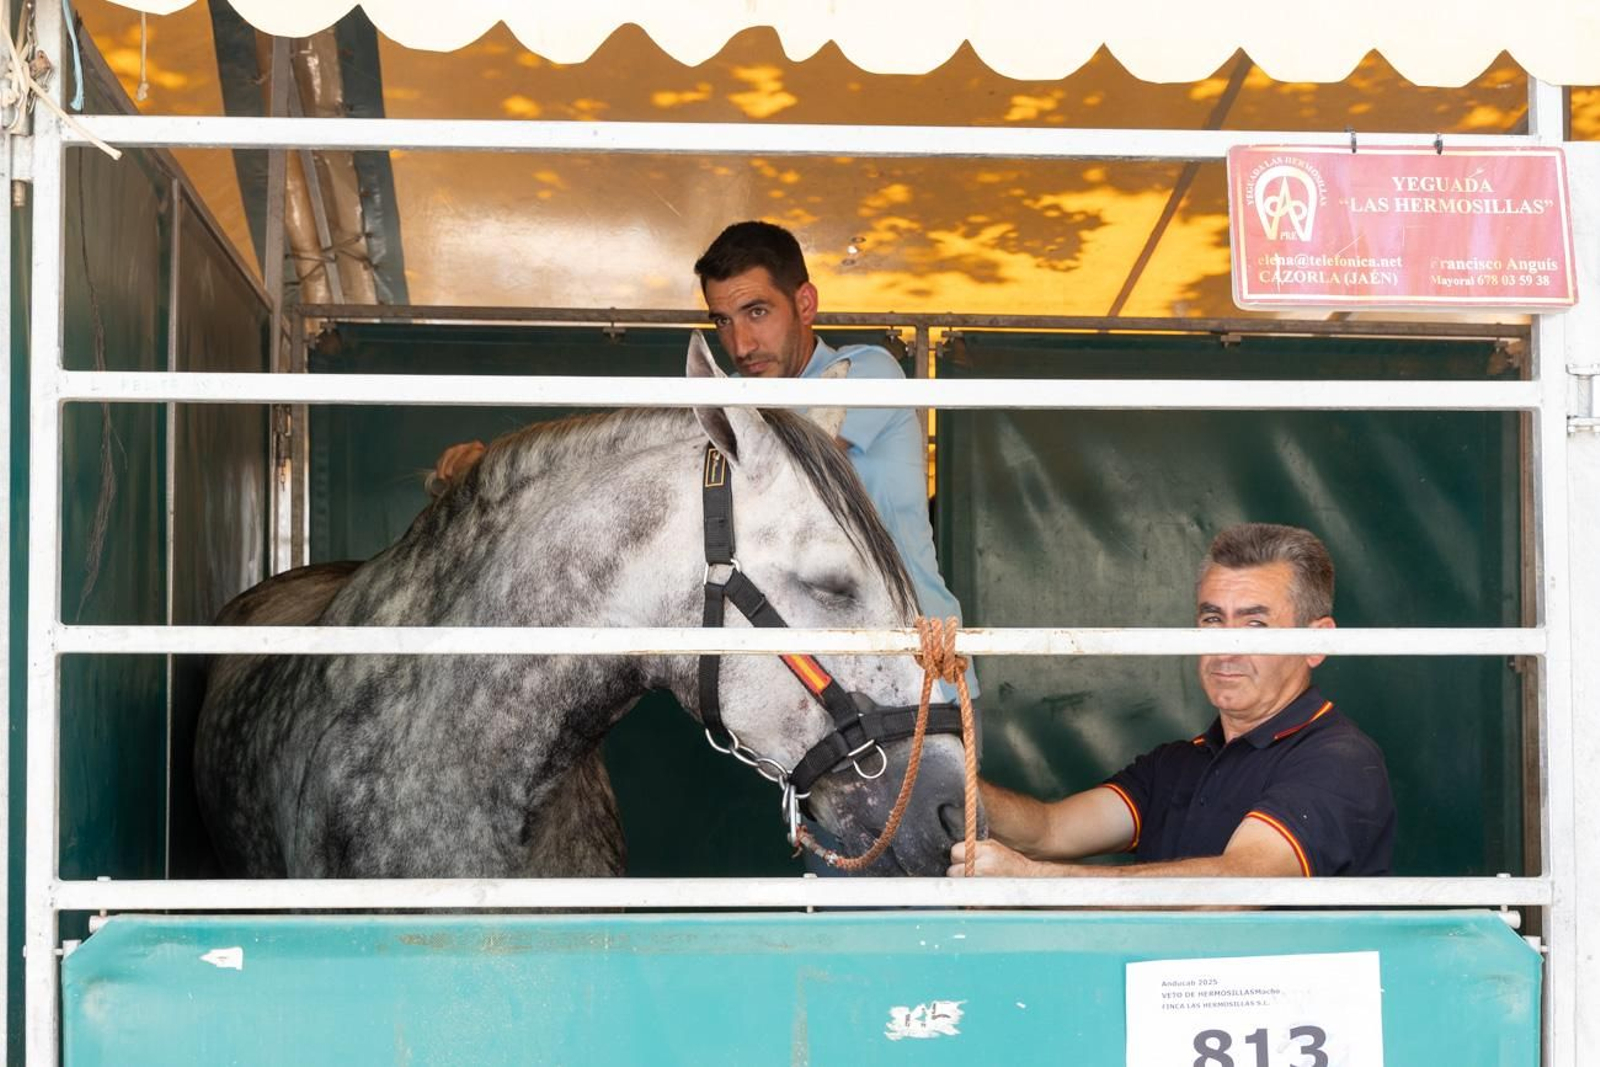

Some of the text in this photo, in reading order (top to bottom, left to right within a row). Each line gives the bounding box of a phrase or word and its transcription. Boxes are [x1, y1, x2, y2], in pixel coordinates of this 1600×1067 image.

[1246, 156, 1328, 207] YEGUADA LAS HERMOSILLAS
[1392, 176, 1493, 193] YEGUADA
[1394, 197, 1554, 215] HERMOSILLAS”
[1506, 257, 1558, 273] Anguís
[1259, 269, 1399, 286] CAZORLA (JAÉN)
[1477, 275, 1499, 286] 678
[1502, 275, 1516, 286] 03
[1519, 275, 1533, 286] 59
[1535, 275, 1550, 286] 38
[1198, 978, 1218, 986] 2025
[1203, 1000, 1255, 1009] HERMOSILLAS
[1193, 1025, 1330, 1067] 813
